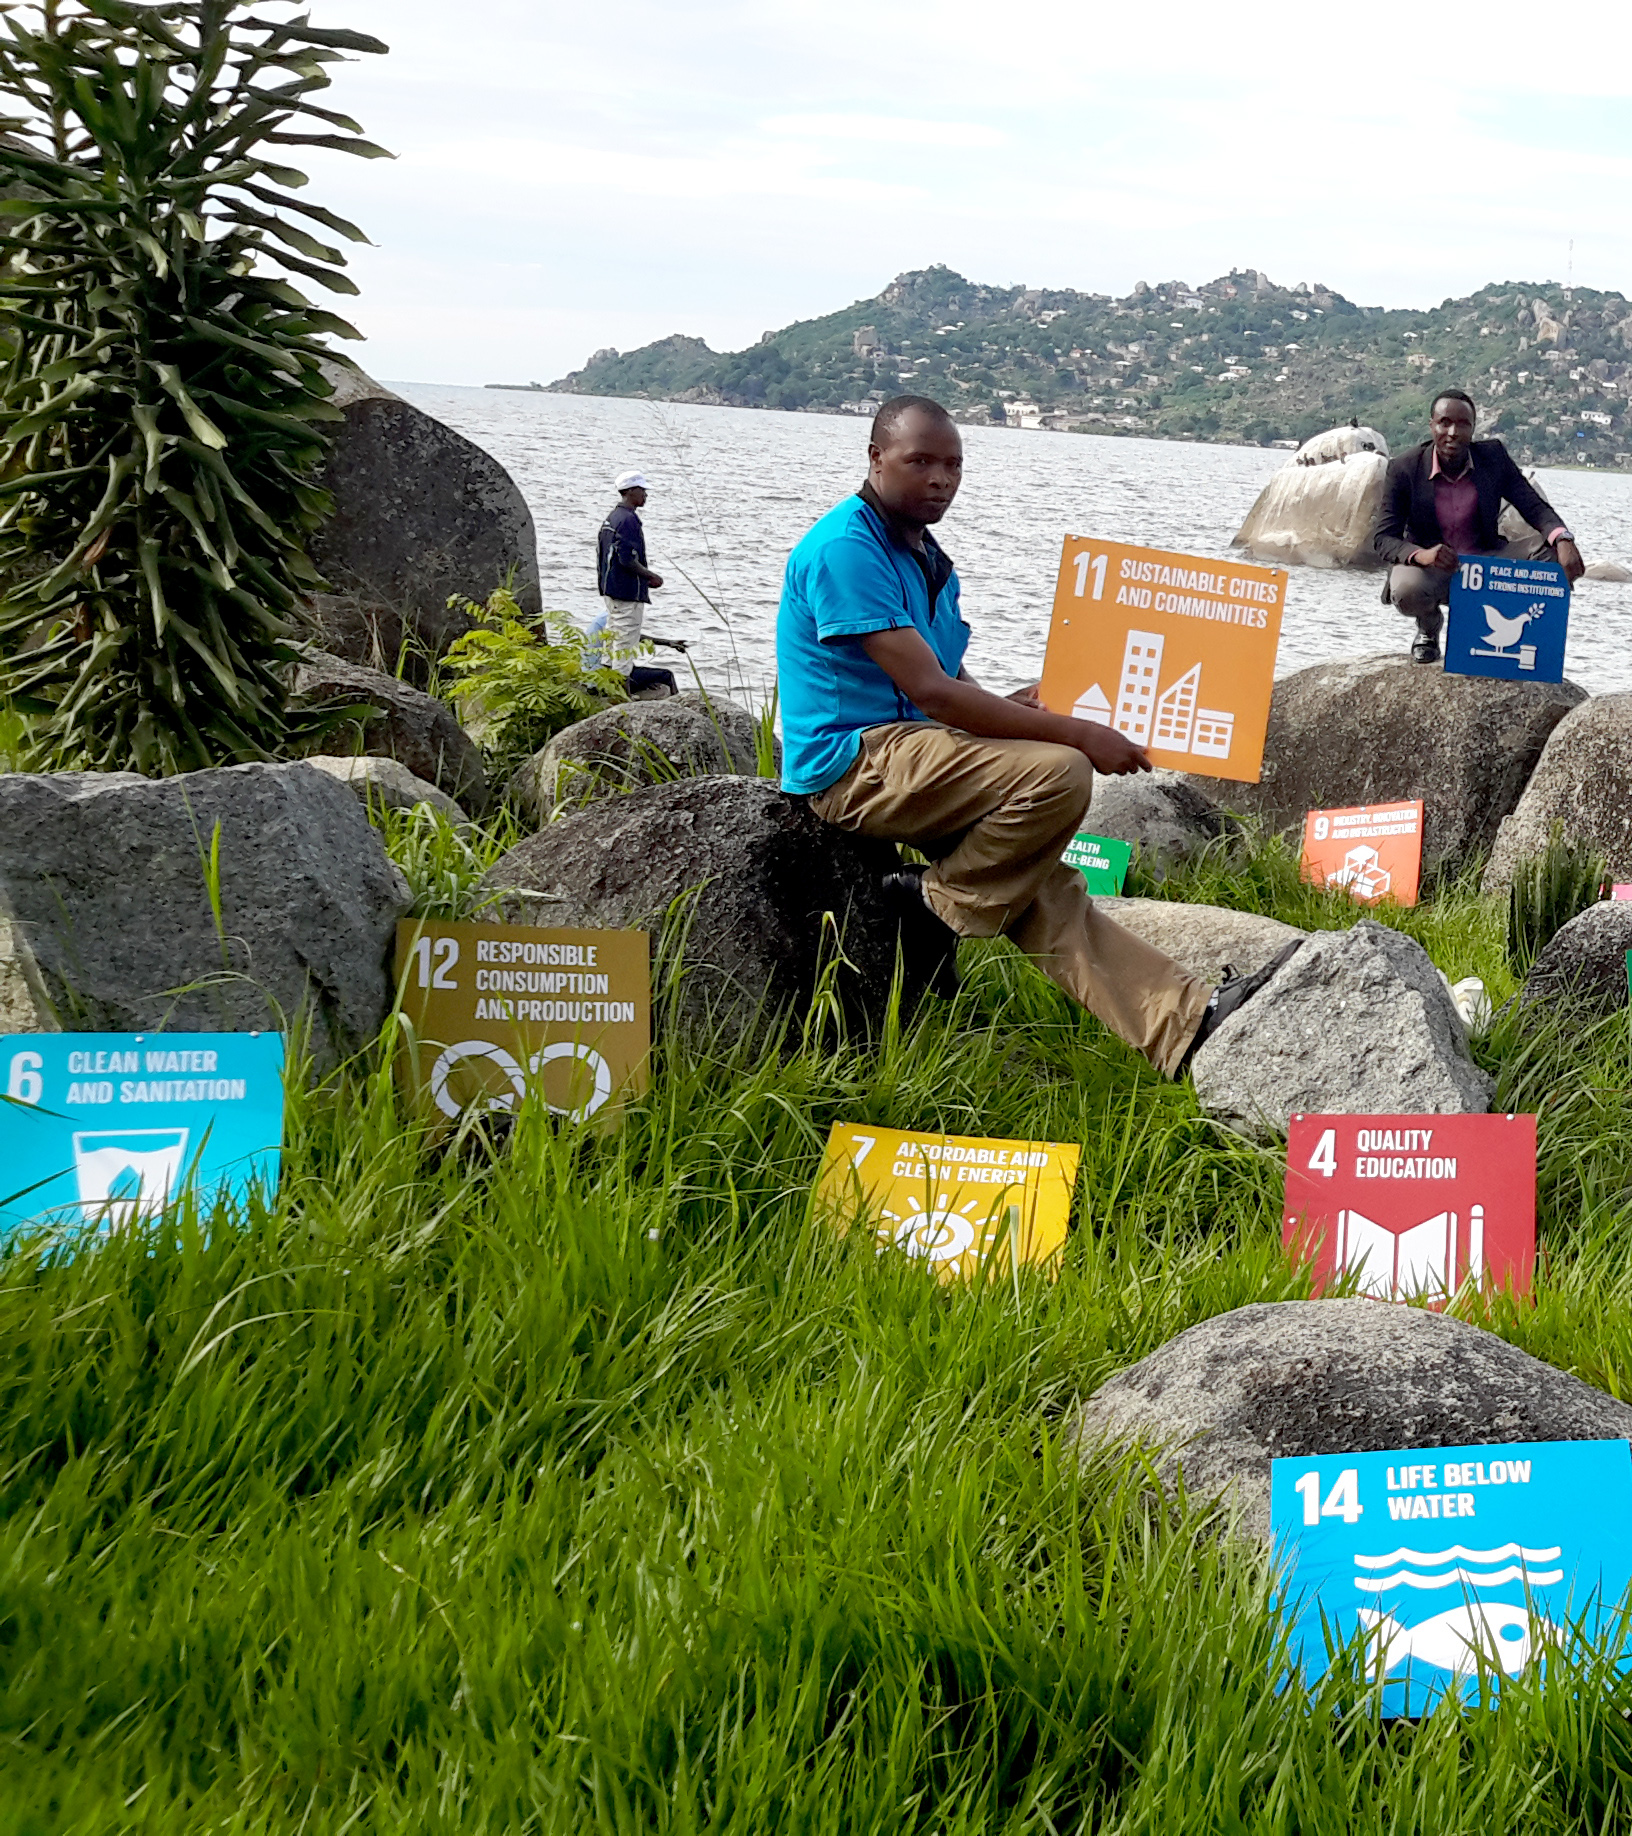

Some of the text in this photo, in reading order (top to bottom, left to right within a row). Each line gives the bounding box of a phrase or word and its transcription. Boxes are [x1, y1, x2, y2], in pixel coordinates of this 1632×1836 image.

[1073, 551, 1108, 601] 11
[1120, 558, 1279, 604] SUSTAINABLE CITIES
[1460, 562, 1484, 591] 16
[1490, 565, 1558, 582] PEACE AND JUSTICE
[1488, 580, 1565, 598] STRONG INSTITUTIONS
[1116, 585, 1268, 629] AND COMMUNITIES
[1314, 816, 1330, 840] 9
[1373, 809, 1418, 823] INNOVATION
[1332, 822, 1417, 839] AND INFRASTRUCTURE
[1060, 851, 1110, 870] ELL-BEING
[1067, 839, 1101, 855] EALTH
[413, 936, 459, 990] 12
[477, 941, 597, 968] RESPONSIBLE
[476, 969, 609, 996] CONSUMPTION
[475, 998, 635, 1023] AND PRODUCTION
[68, 1050, 218, 1076] CLEAN WATER
[9, 1051, 43, 1105] 6
[65, 1078, 246, 1105] AND SANITATION
[847, 1135, 876, 1170] 7
[1307, 1129, 1338, 1178] 4
[1356, 1128, 1433, 1153] QUALITY
[896, 1141, 1049, 1168] AFFORDABLE AND
[1355, 1156, 1458, 1179] EDUCATION
[892, 1161, 1027, 1184] CLEAN ENERGY
[1386, 1459, 1532, 1491] LIFE BELOW
[1295, 1468, 1363, 1526] 14
[1388, 1492, 1475, 1521] WATER
